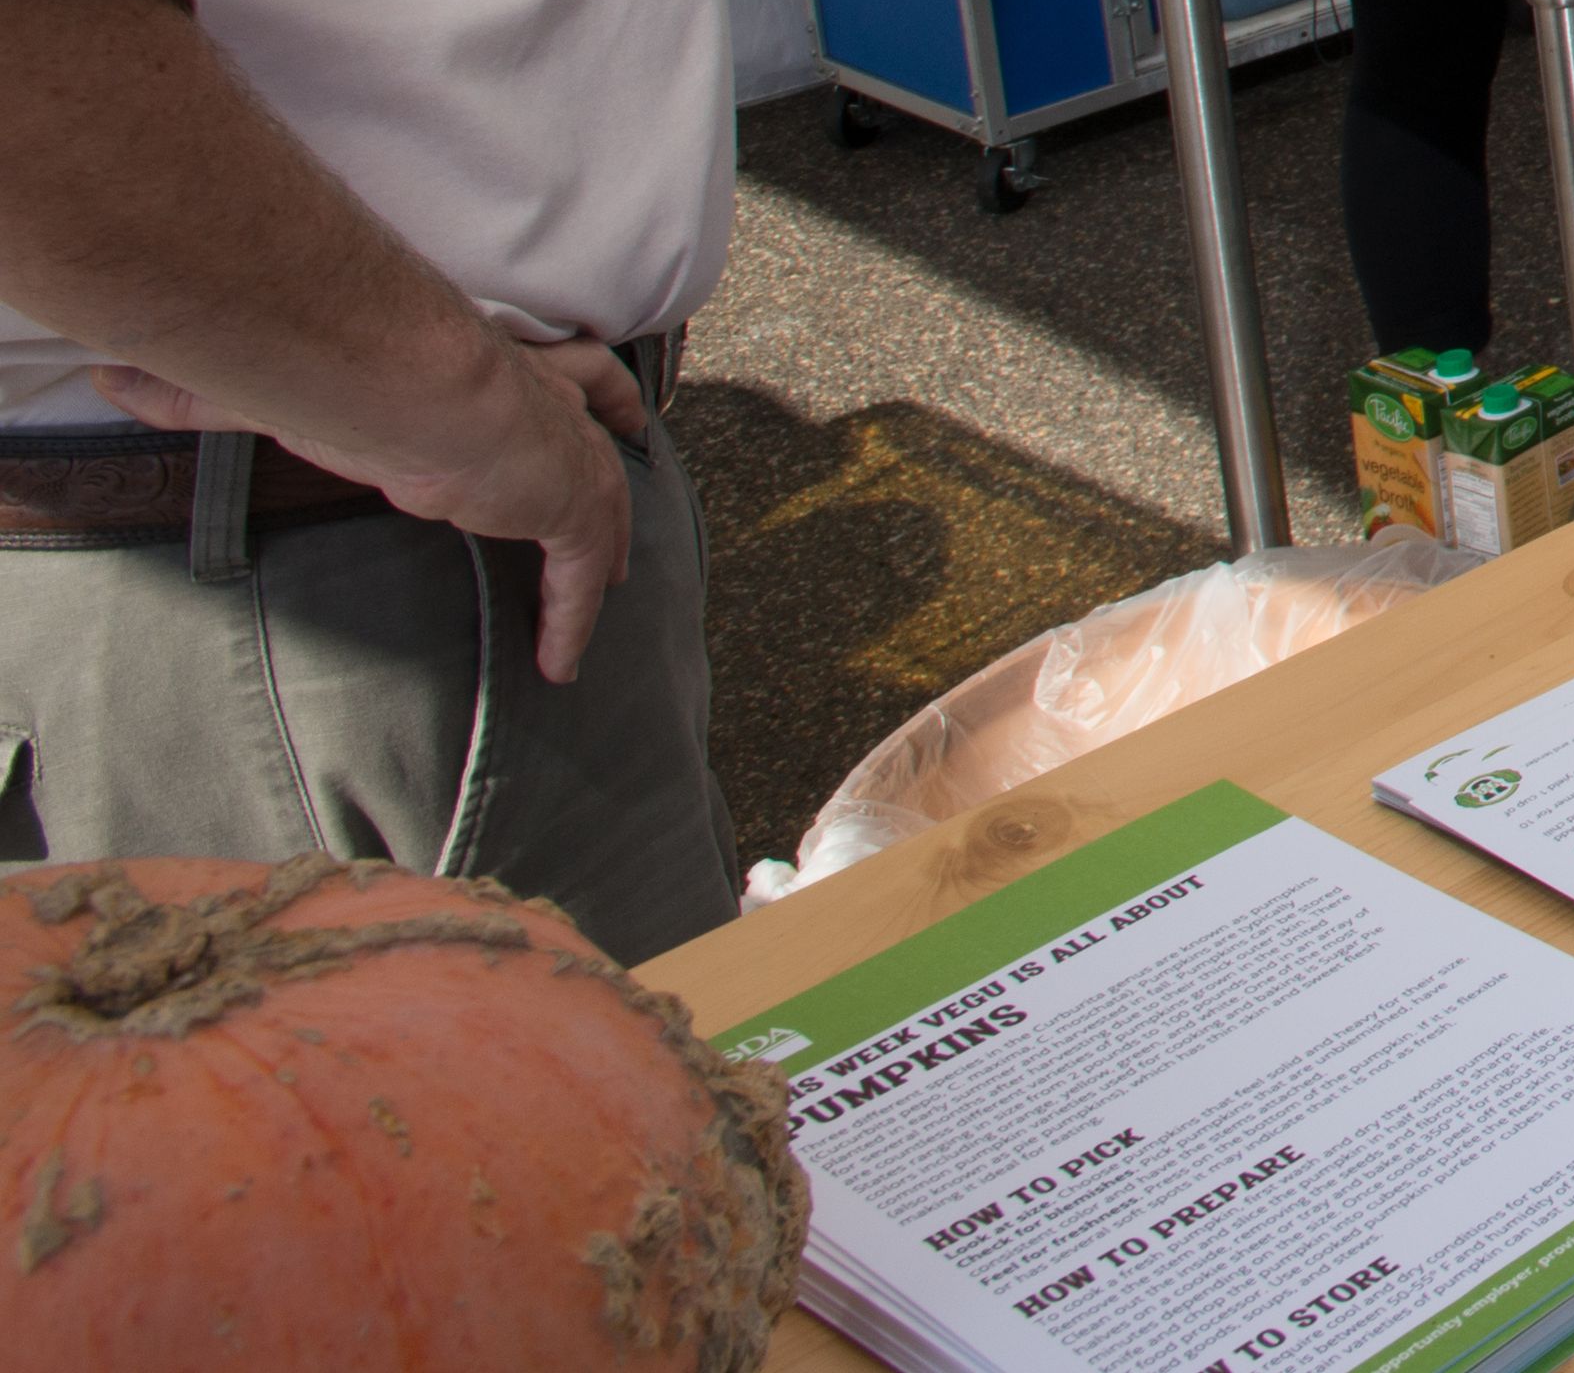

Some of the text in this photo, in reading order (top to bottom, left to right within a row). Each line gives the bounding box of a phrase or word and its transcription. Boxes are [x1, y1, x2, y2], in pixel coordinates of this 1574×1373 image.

[1362, 458, 1425, 493] vegetable
[1378, 483, 1416, 511] broth
[825, 874, 1206, 1077] WEEK VEGU IS ALL ABOUT
[786, 1002, 1028, 1140] PUMPKINS
[922, 1127, 1146, 1253] HOW TO PICK
[944, 1201, 1056, 1260] Look at size.
[956, 1169, 1140, 1269] Check for blemishes.
[980, 1196, 1144, 1286] Feel for freshness.
[1013, 1144, 1306, 1319] HOW TO PREPARE
[1232, 1254, 1400, 1363] TO STORE
[1371, 1313, 1464, 1373] pportunity
[1461, 1264, 1541, 1319] employer,
